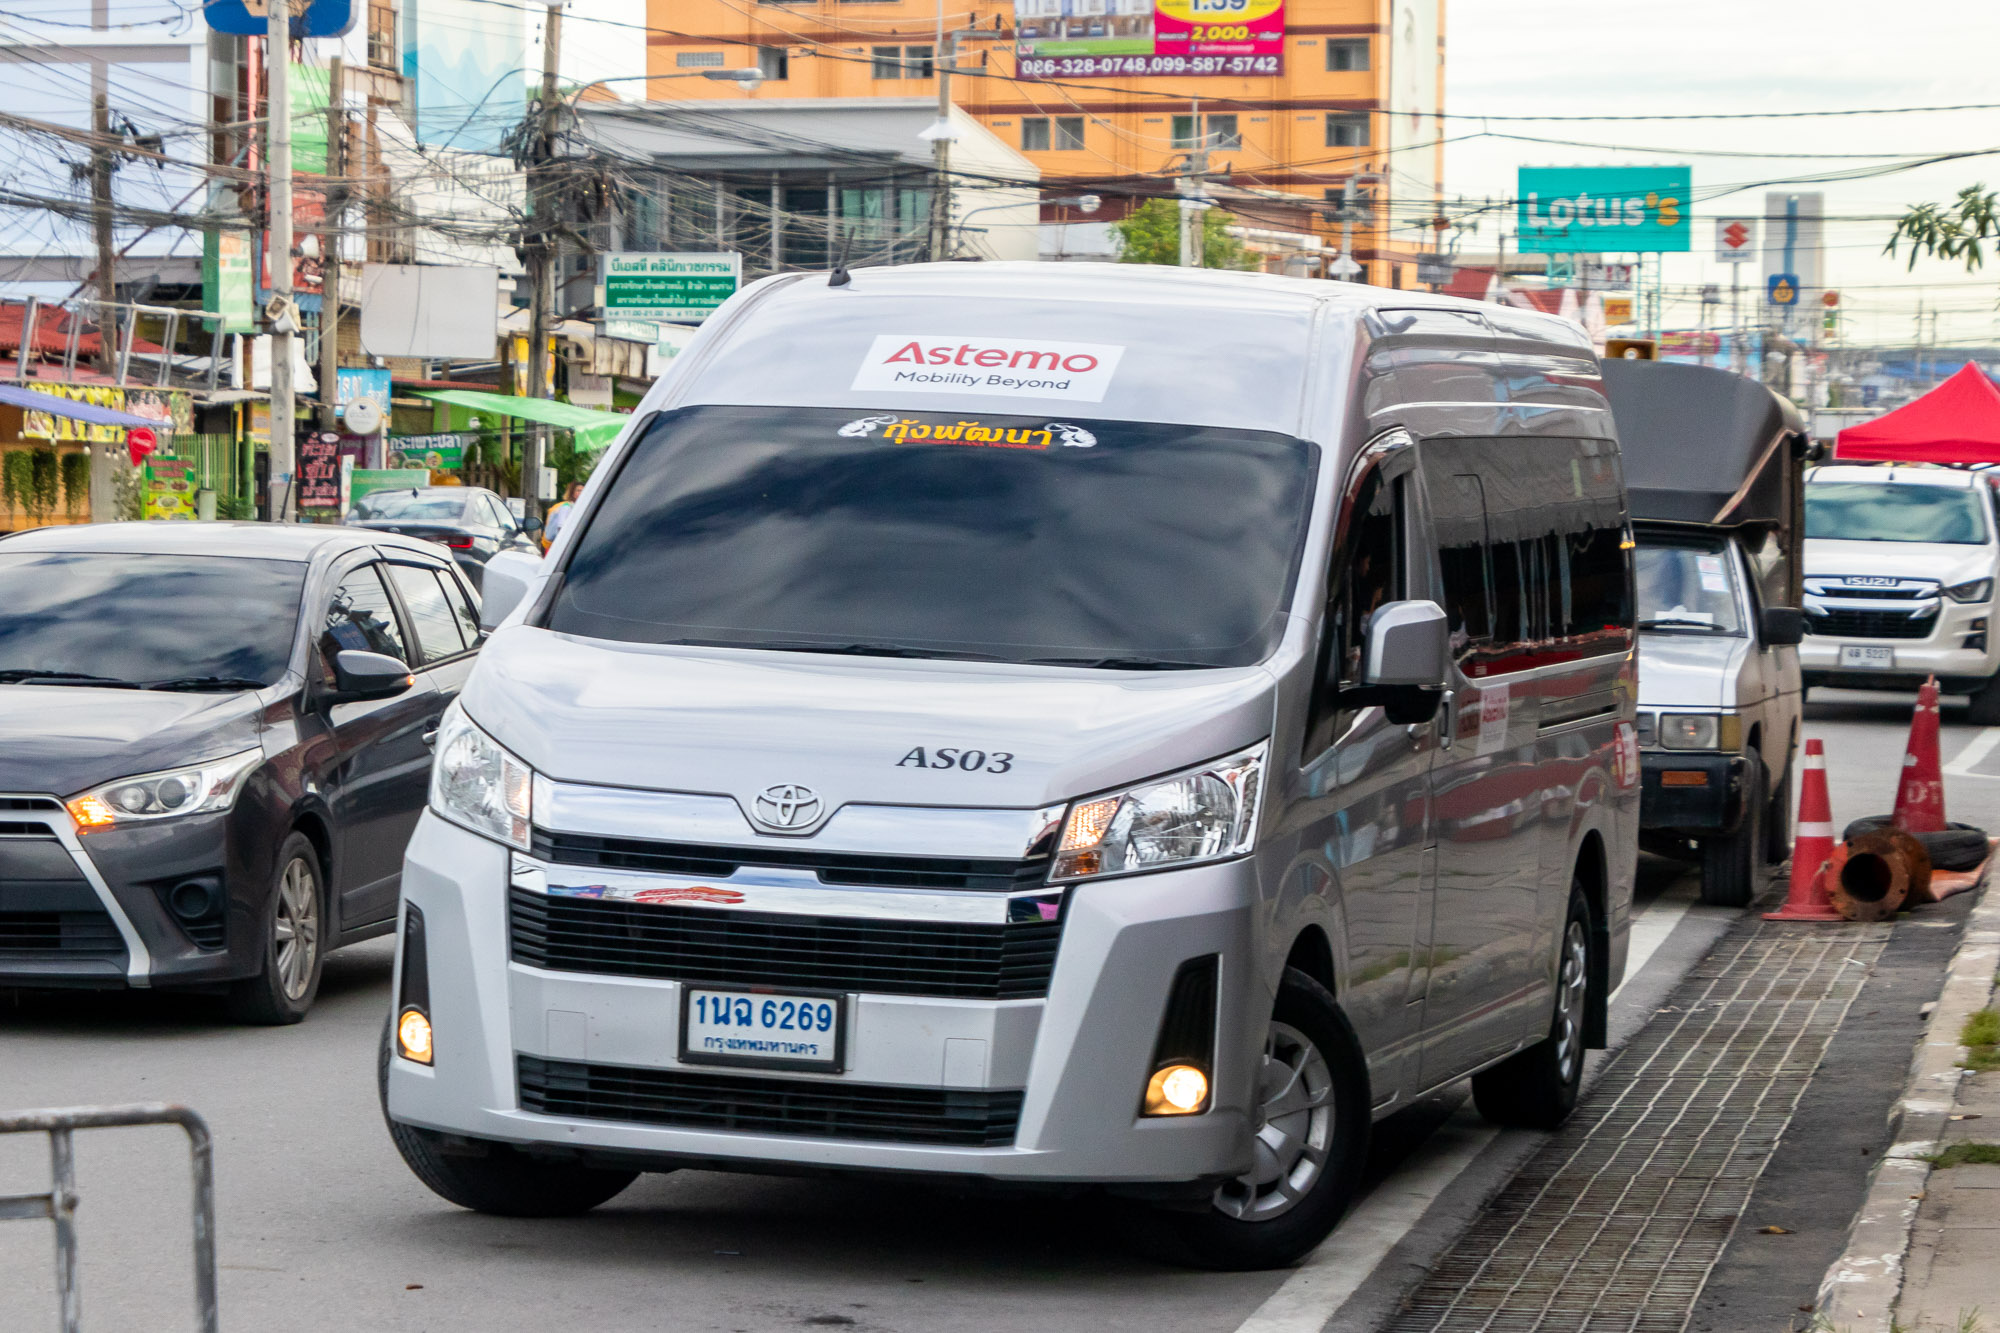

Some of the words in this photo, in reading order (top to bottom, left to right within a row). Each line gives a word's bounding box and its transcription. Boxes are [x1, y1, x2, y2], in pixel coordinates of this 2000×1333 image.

[1527, 192, 1681, 227] Lotus's
[883, 341, 1098, 373] Astemo
[894, 371, 982, 387] Mobility
[986, 374, 1071, 390] Beyond
[390, 433, 462, 450] กระเพาะปลา
[882, 419, 1053, 446] กุ้งพัฒนา
[1847, 577, 1896, 586] ISUZU
[895, 746, 1015, 774] AS03
[696, 995, 752, 1027] 1นฉ
[761, 1000, 832, 1032] 6269
[704, 1036, 818, 1055] กรุงเทพมหานคร
